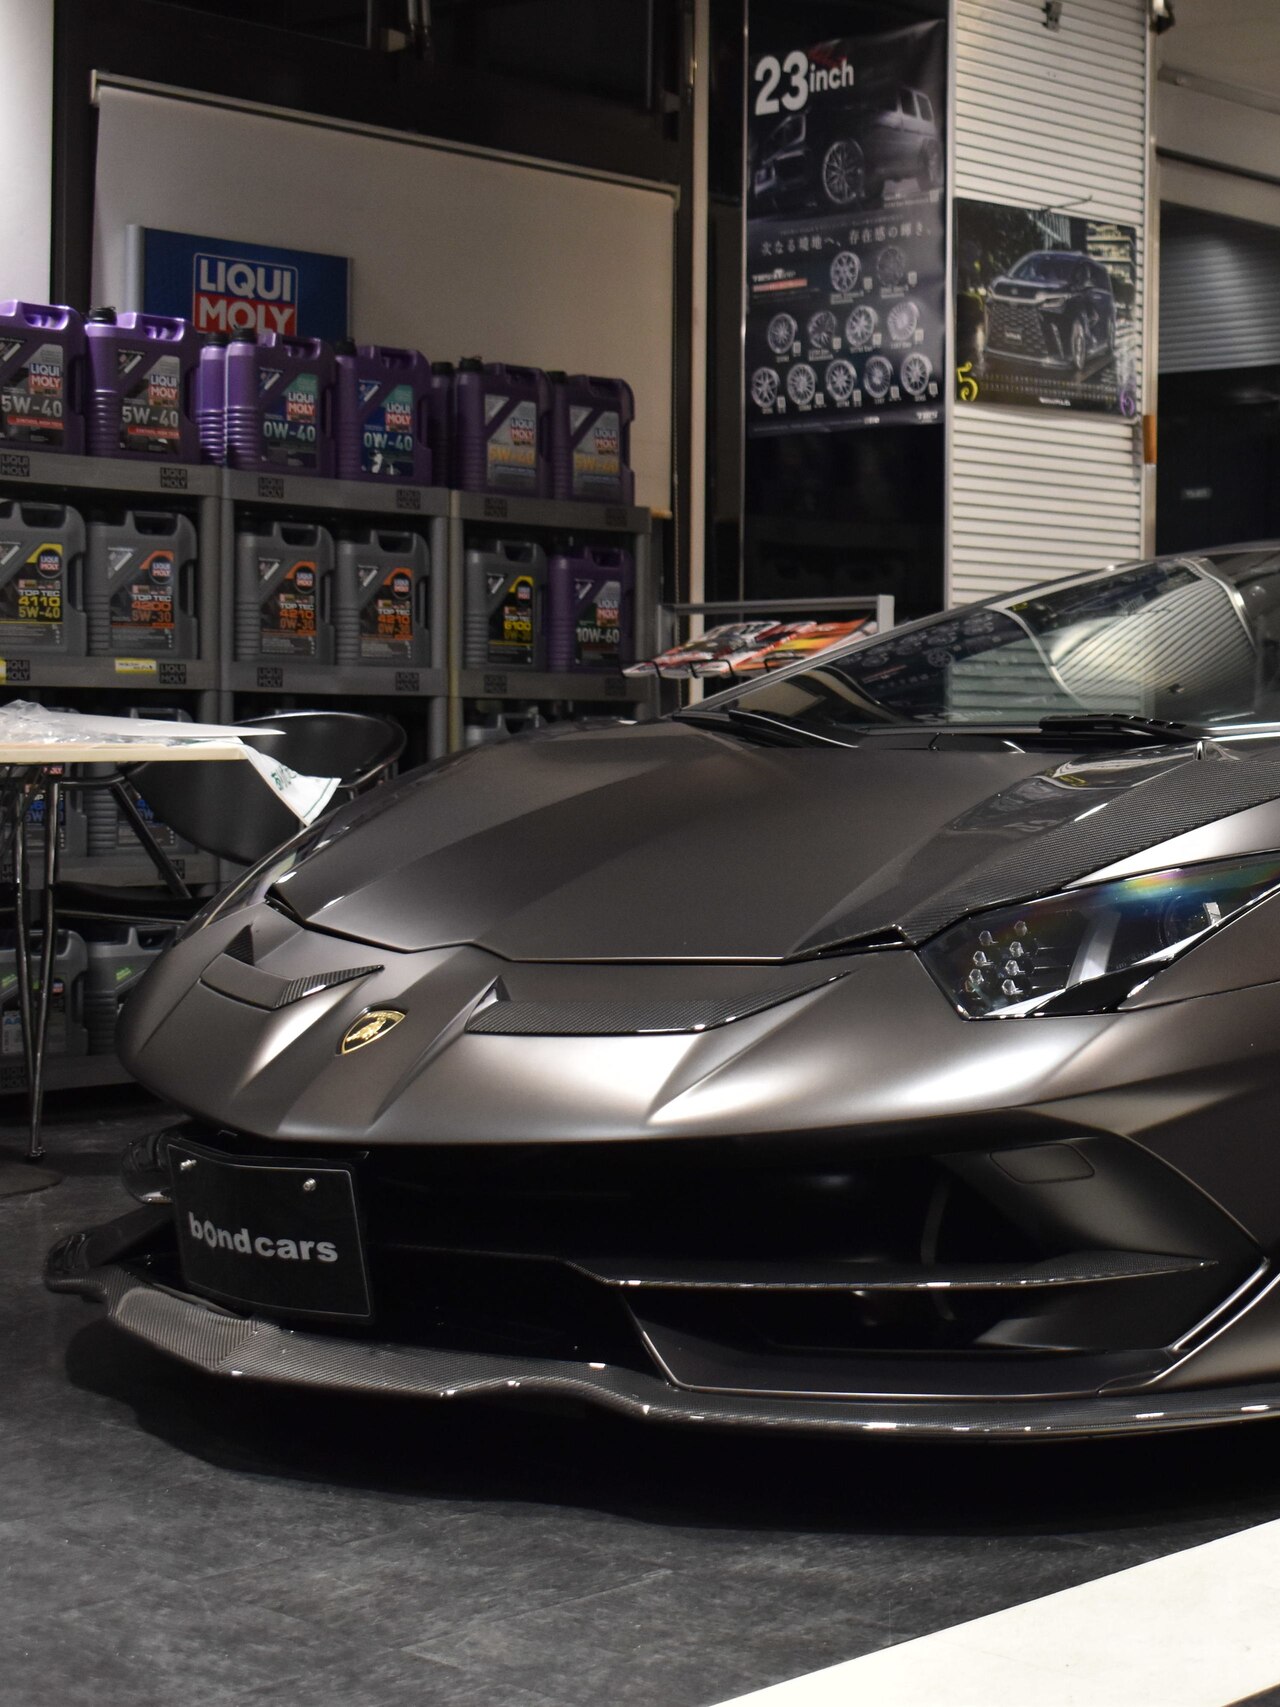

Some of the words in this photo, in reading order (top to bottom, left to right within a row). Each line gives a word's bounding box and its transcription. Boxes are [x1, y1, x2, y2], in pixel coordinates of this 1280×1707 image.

[200, 258, 292, 302] LIQUI
[199, 296, 294, 335] MOLY
[30, 363, 60, 376] LIQUI
[31, 375, 61, 388] MOLY
[150, 374, 177, 388] LIQUI
[957, 361, 978, 401] 5
[150, 387, 178, 399] MOLY
[288, 392, 314, 403] LIQUI
[1, 395, 63, 417] 5W-40
[288, 402, 315, 415] MOLY
[387, 402, 411, 414] LIQUI
[122, 406, 179, 428] 5W-40
[387, 413, 412, 426] MOLY
[263, 421, 316, 442] 0W-40
[511, 428, 535, 440] MOLY
[363, 432, 413, 450] 0W-40
[18, 596, 60, 606] 4110
[19, 606, 61, 618] 5W-40
[132, 611, 171, 622] 5W-30
[597, 608, 619, 618] MOLY
[576, 628, 620, 643] 10W-60
